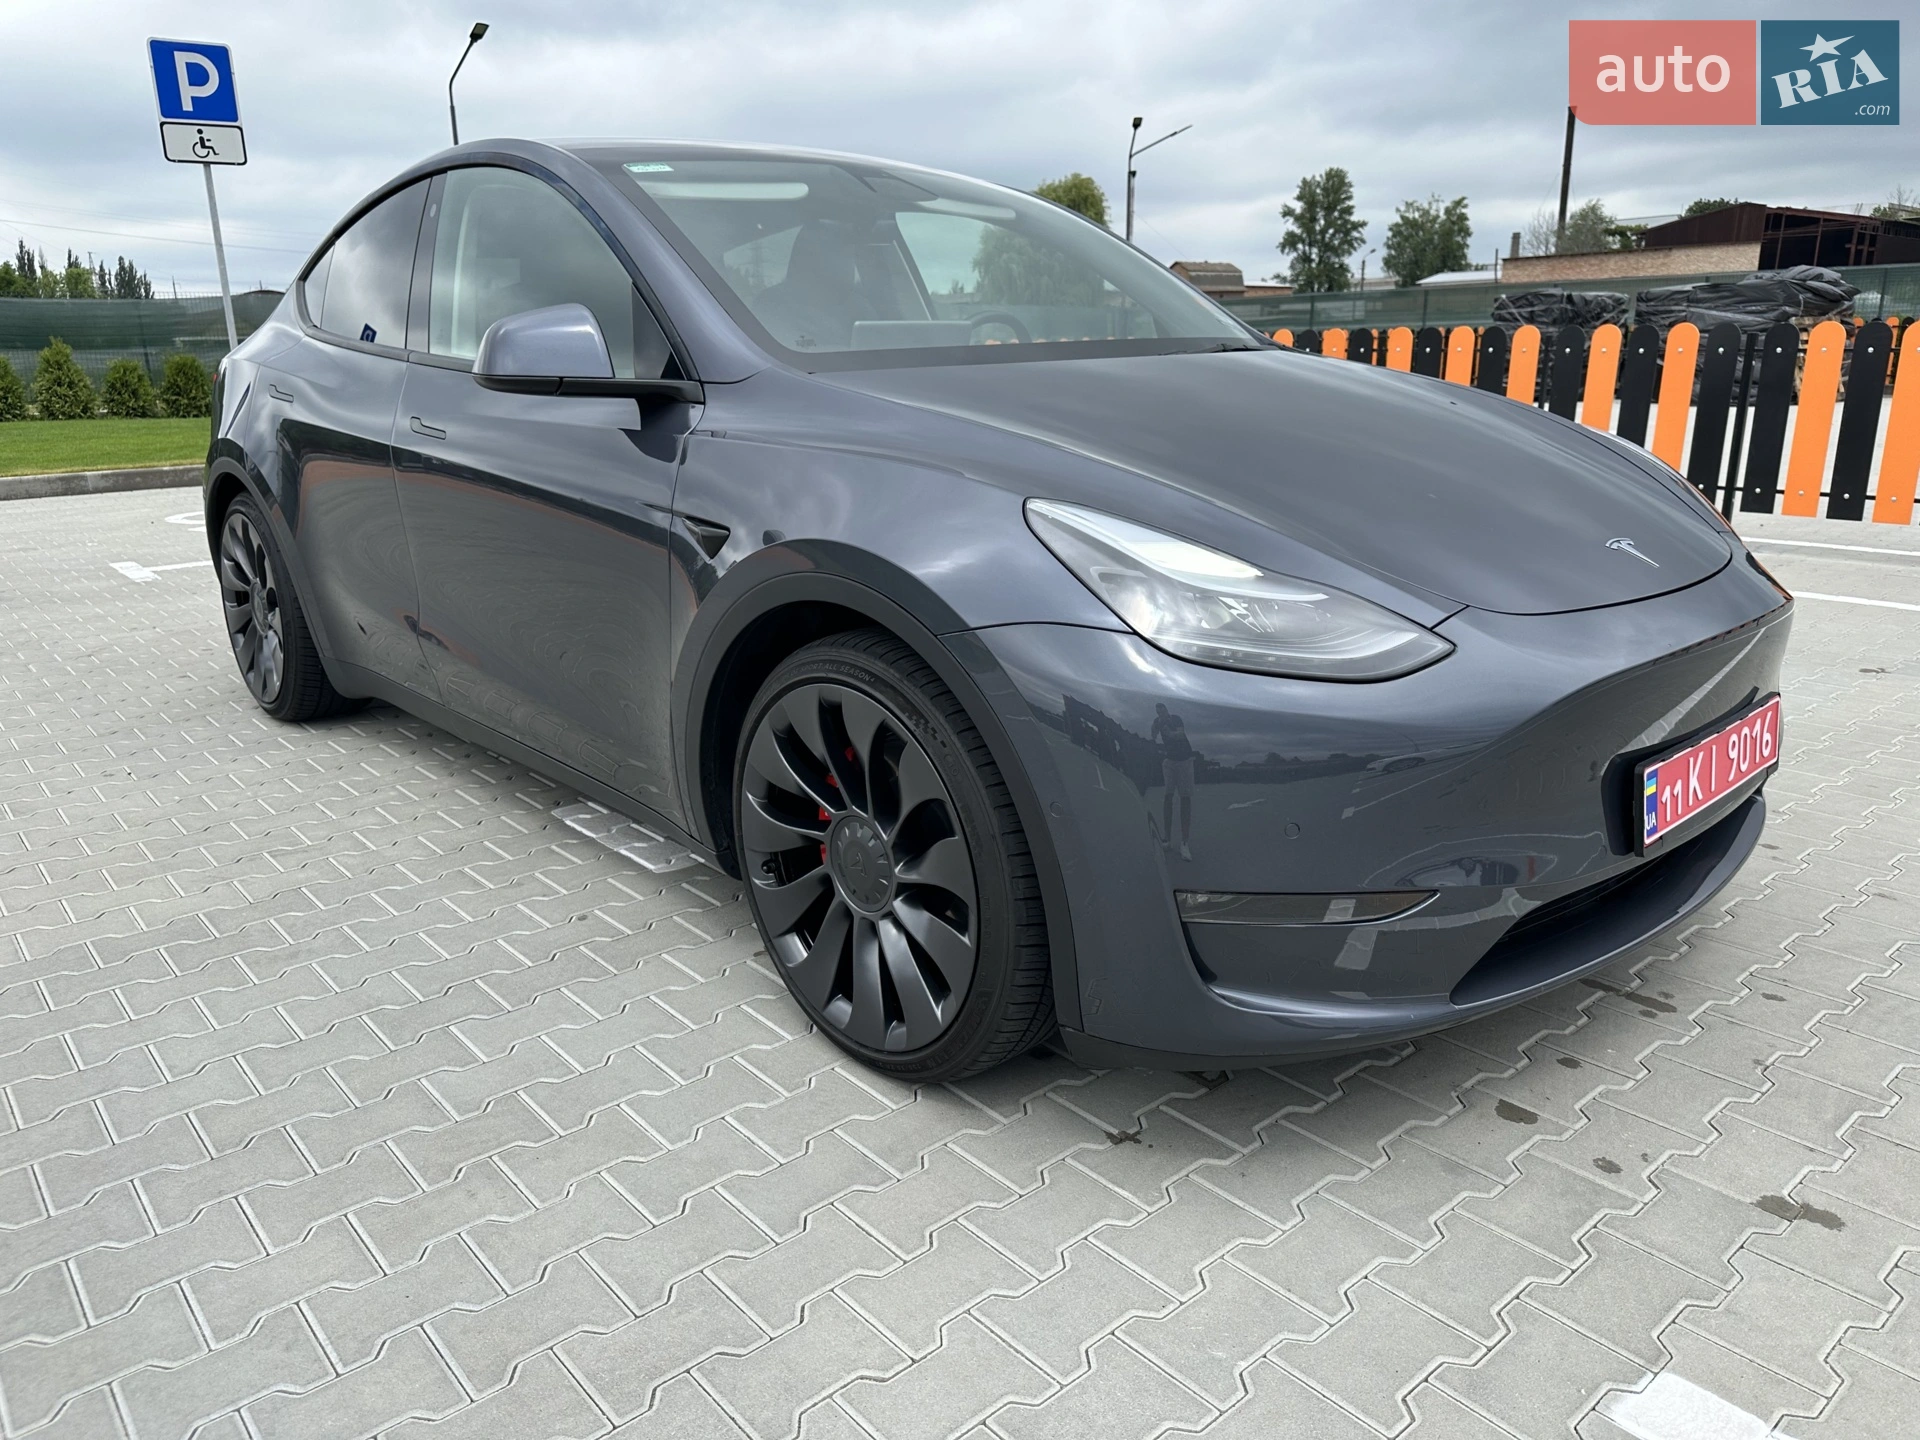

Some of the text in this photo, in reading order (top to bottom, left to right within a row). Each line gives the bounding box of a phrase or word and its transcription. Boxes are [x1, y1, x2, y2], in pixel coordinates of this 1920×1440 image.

[173, 50, 220, 112] P
[1727, 710, 1773, 783] 9016
[1645, 812, 1657, 830] UA
